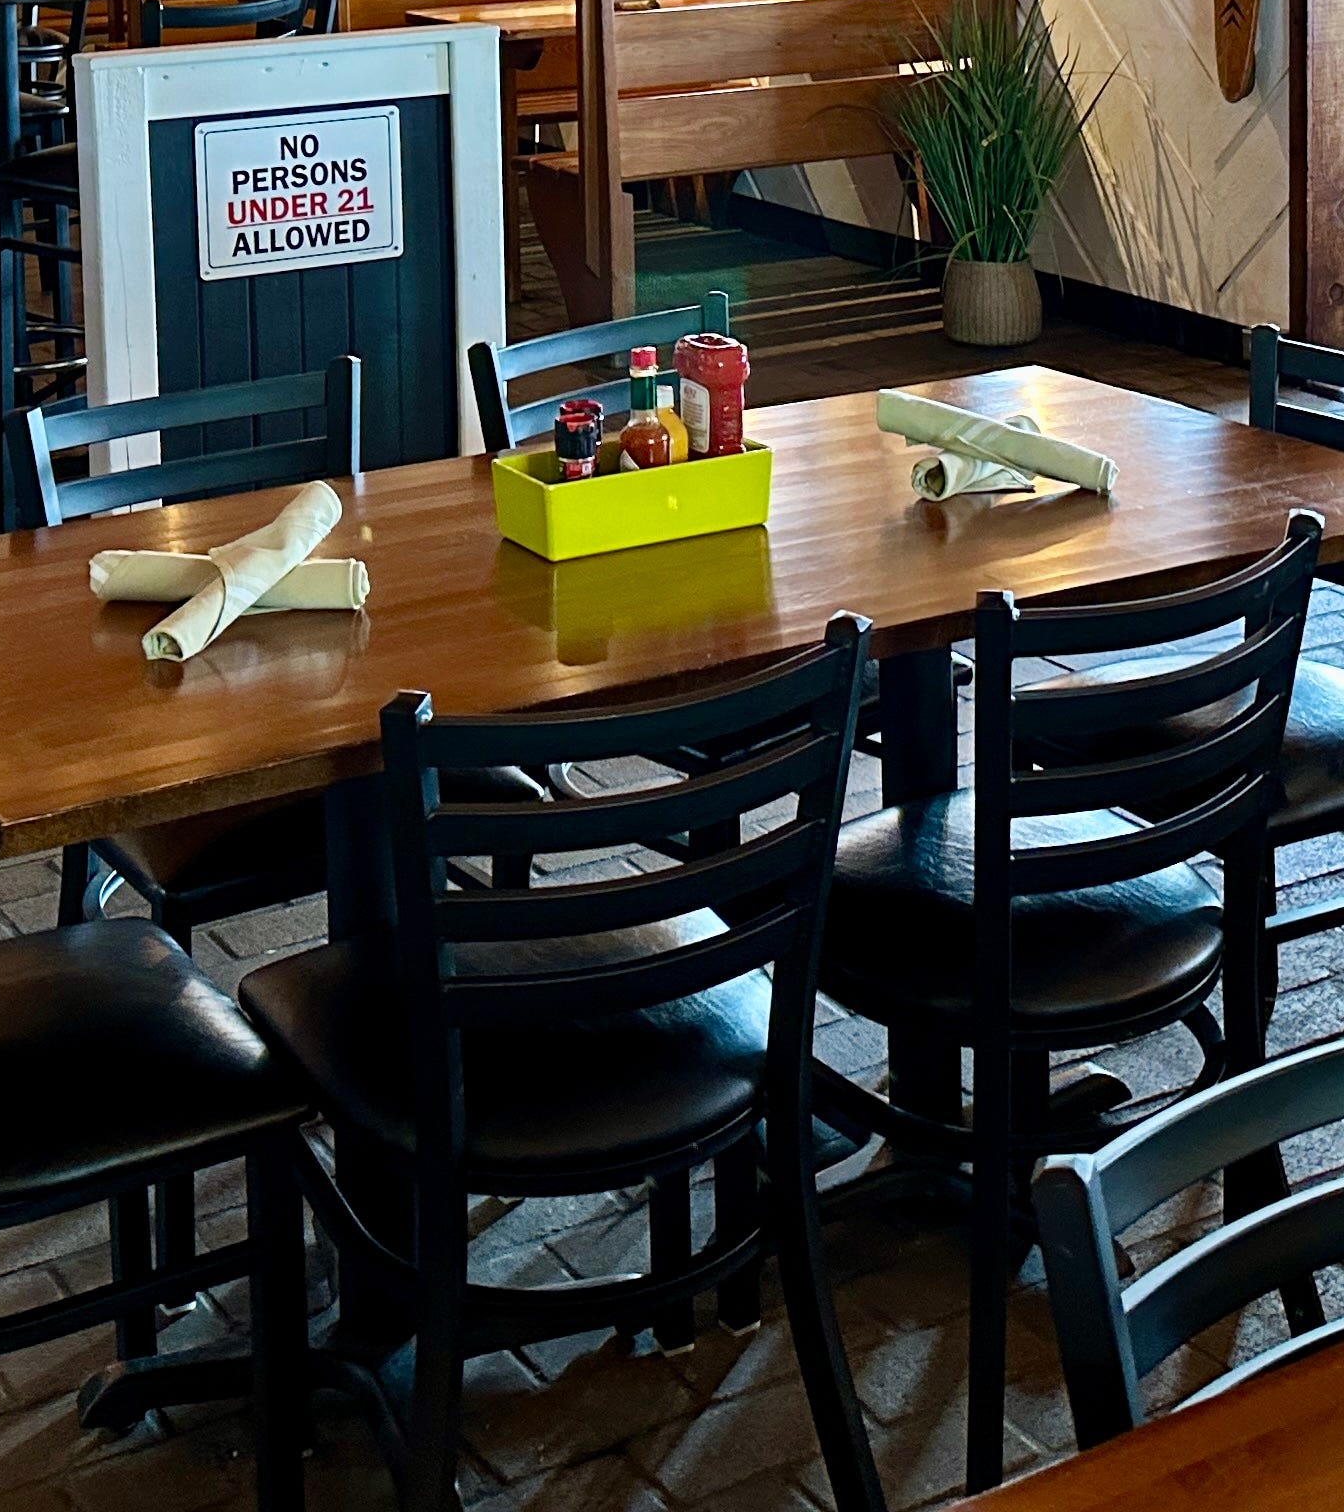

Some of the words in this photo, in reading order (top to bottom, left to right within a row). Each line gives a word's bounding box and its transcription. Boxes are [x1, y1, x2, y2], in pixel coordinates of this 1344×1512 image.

[280, 134, 319, 160] NO
[232, 158, 368, 195] PERSONS
[227, 191, 328, 225] UNDER
[337, 186, 375, 213] 21
[232, 219, 371, 257] ALLOWED
